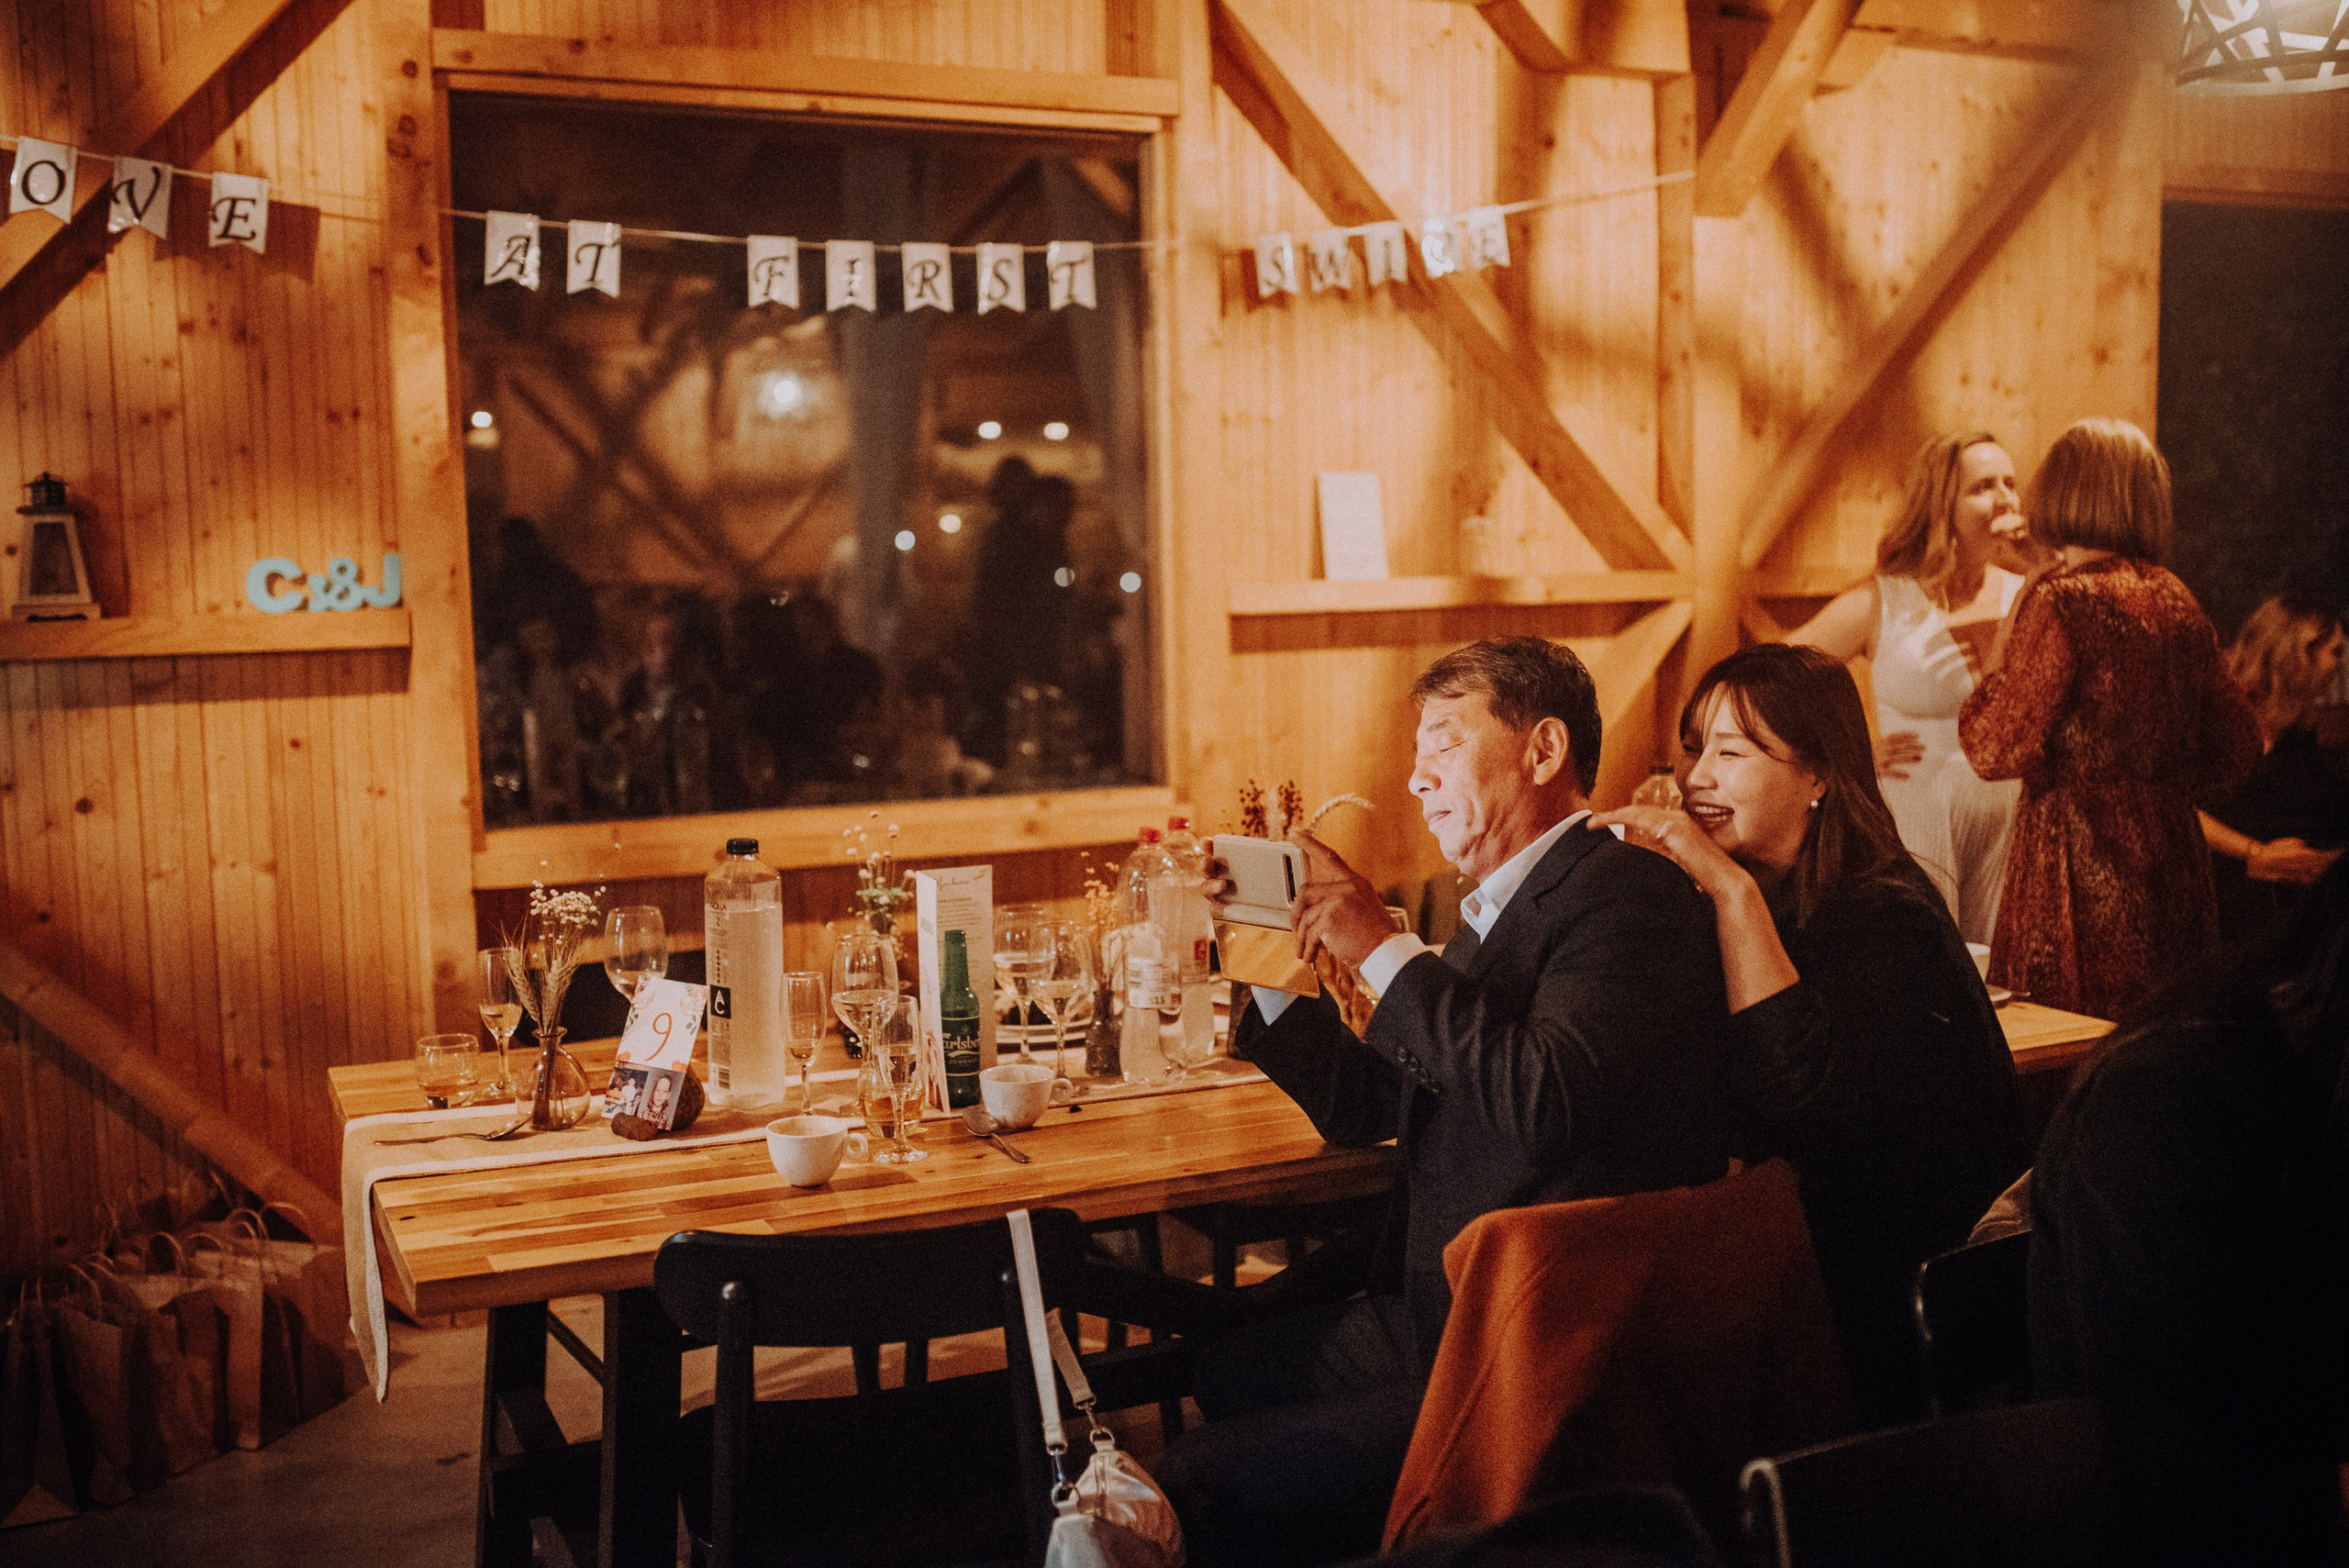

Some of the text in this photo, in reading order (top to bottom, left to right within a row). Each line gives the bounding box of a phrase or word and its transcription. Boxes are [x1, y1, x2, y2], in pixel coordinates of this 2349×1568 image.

[490, 233, 619, 284] AT
[752, 254, 1087, 302] FIRST
[645, 1012, 673, 1062] 9
